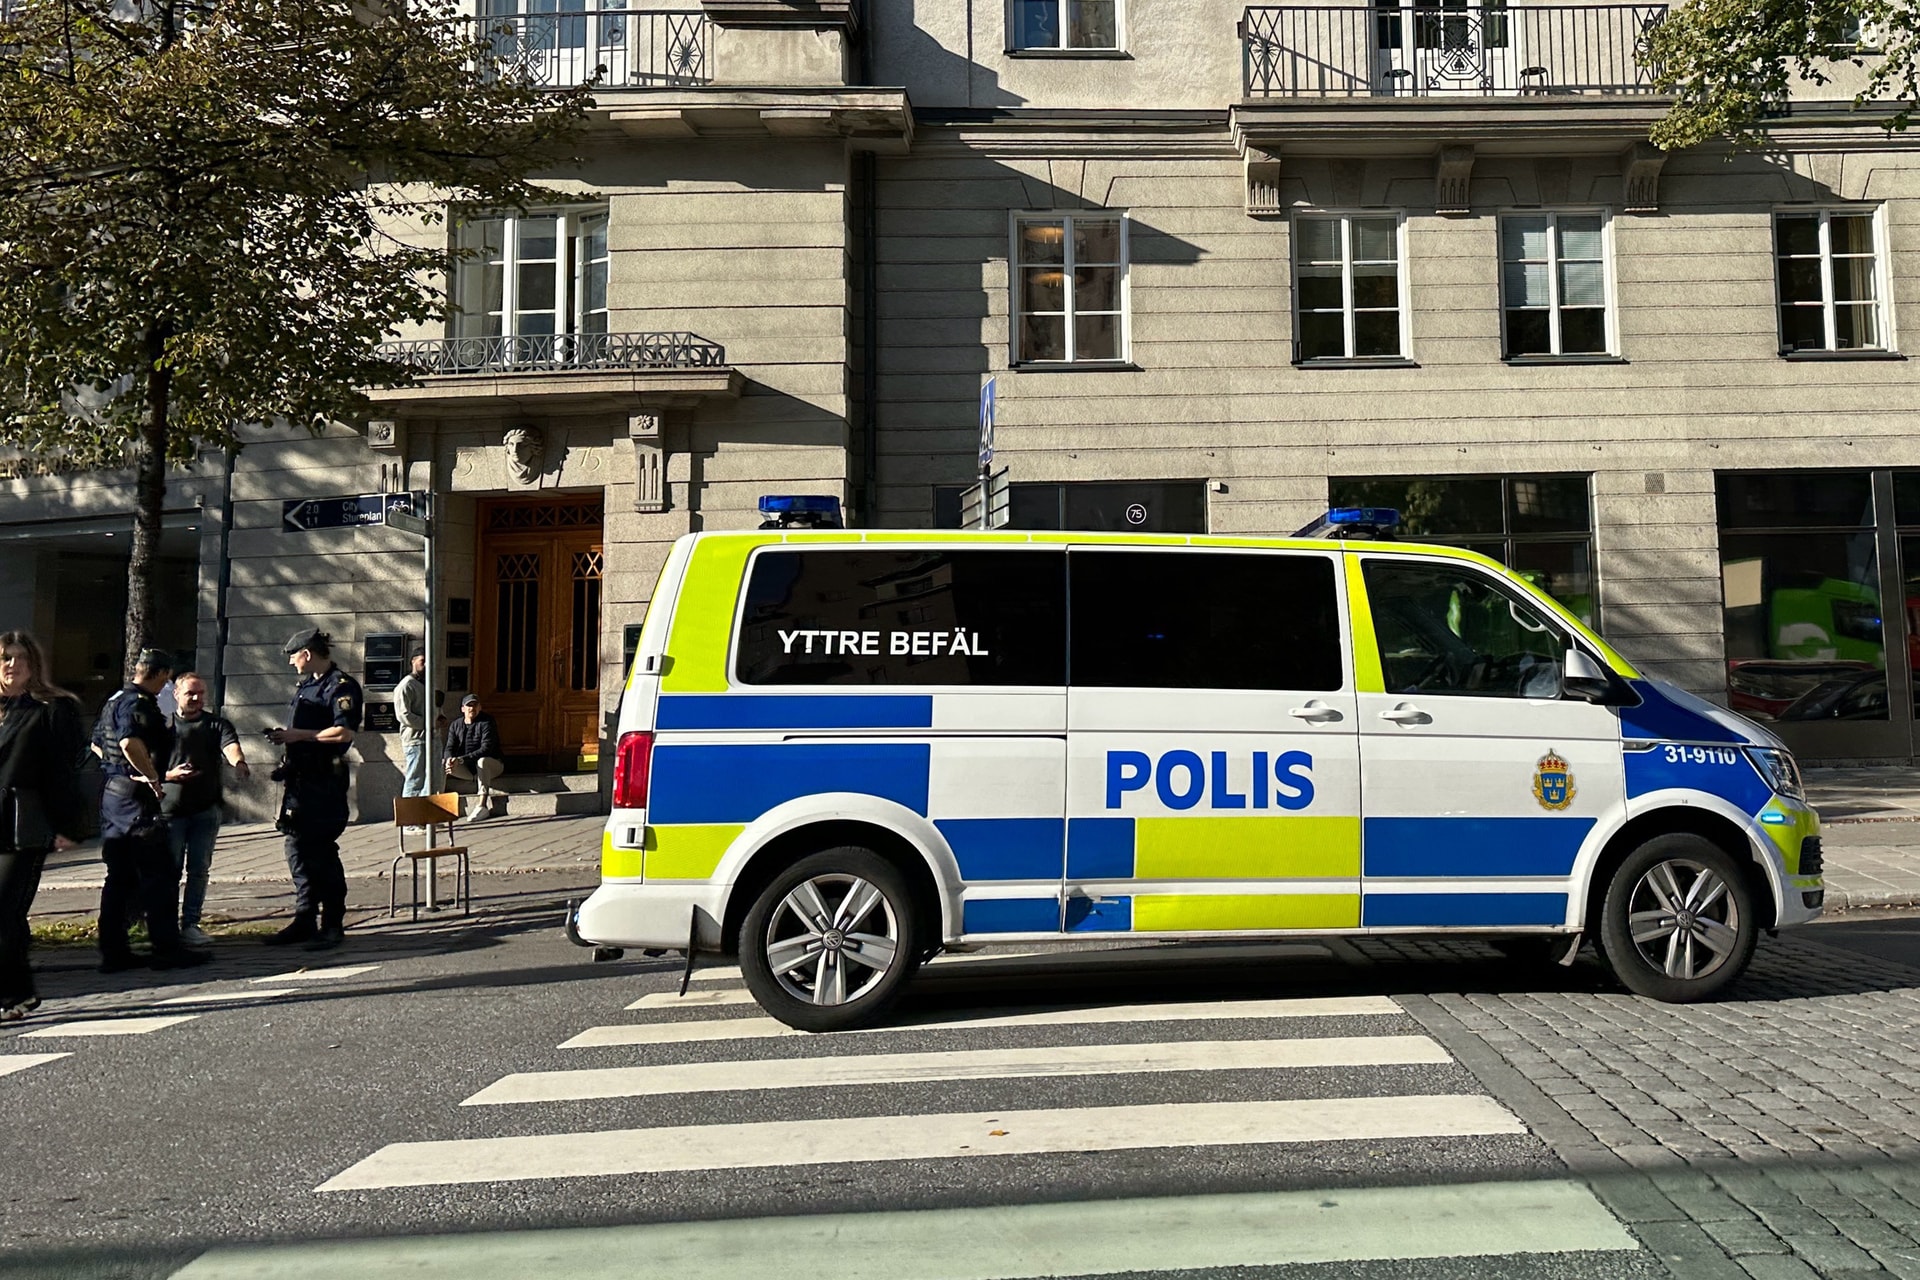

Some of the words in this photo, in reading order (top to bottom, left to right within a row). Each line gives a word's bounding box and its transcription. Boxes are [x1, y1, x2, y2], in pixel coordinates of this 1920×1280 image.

[576, 447, 602, 472] 75
[342, 501, 358, 513] City
[342, 511, 382, 523] Stureplan
[777, 629, 881, 655] YTTRE
[889, 627, 989, 656] BEFÄL
[1664, 745, 1737, 765] 31-9110
[1105, 749, 1315, 811] POLIS
